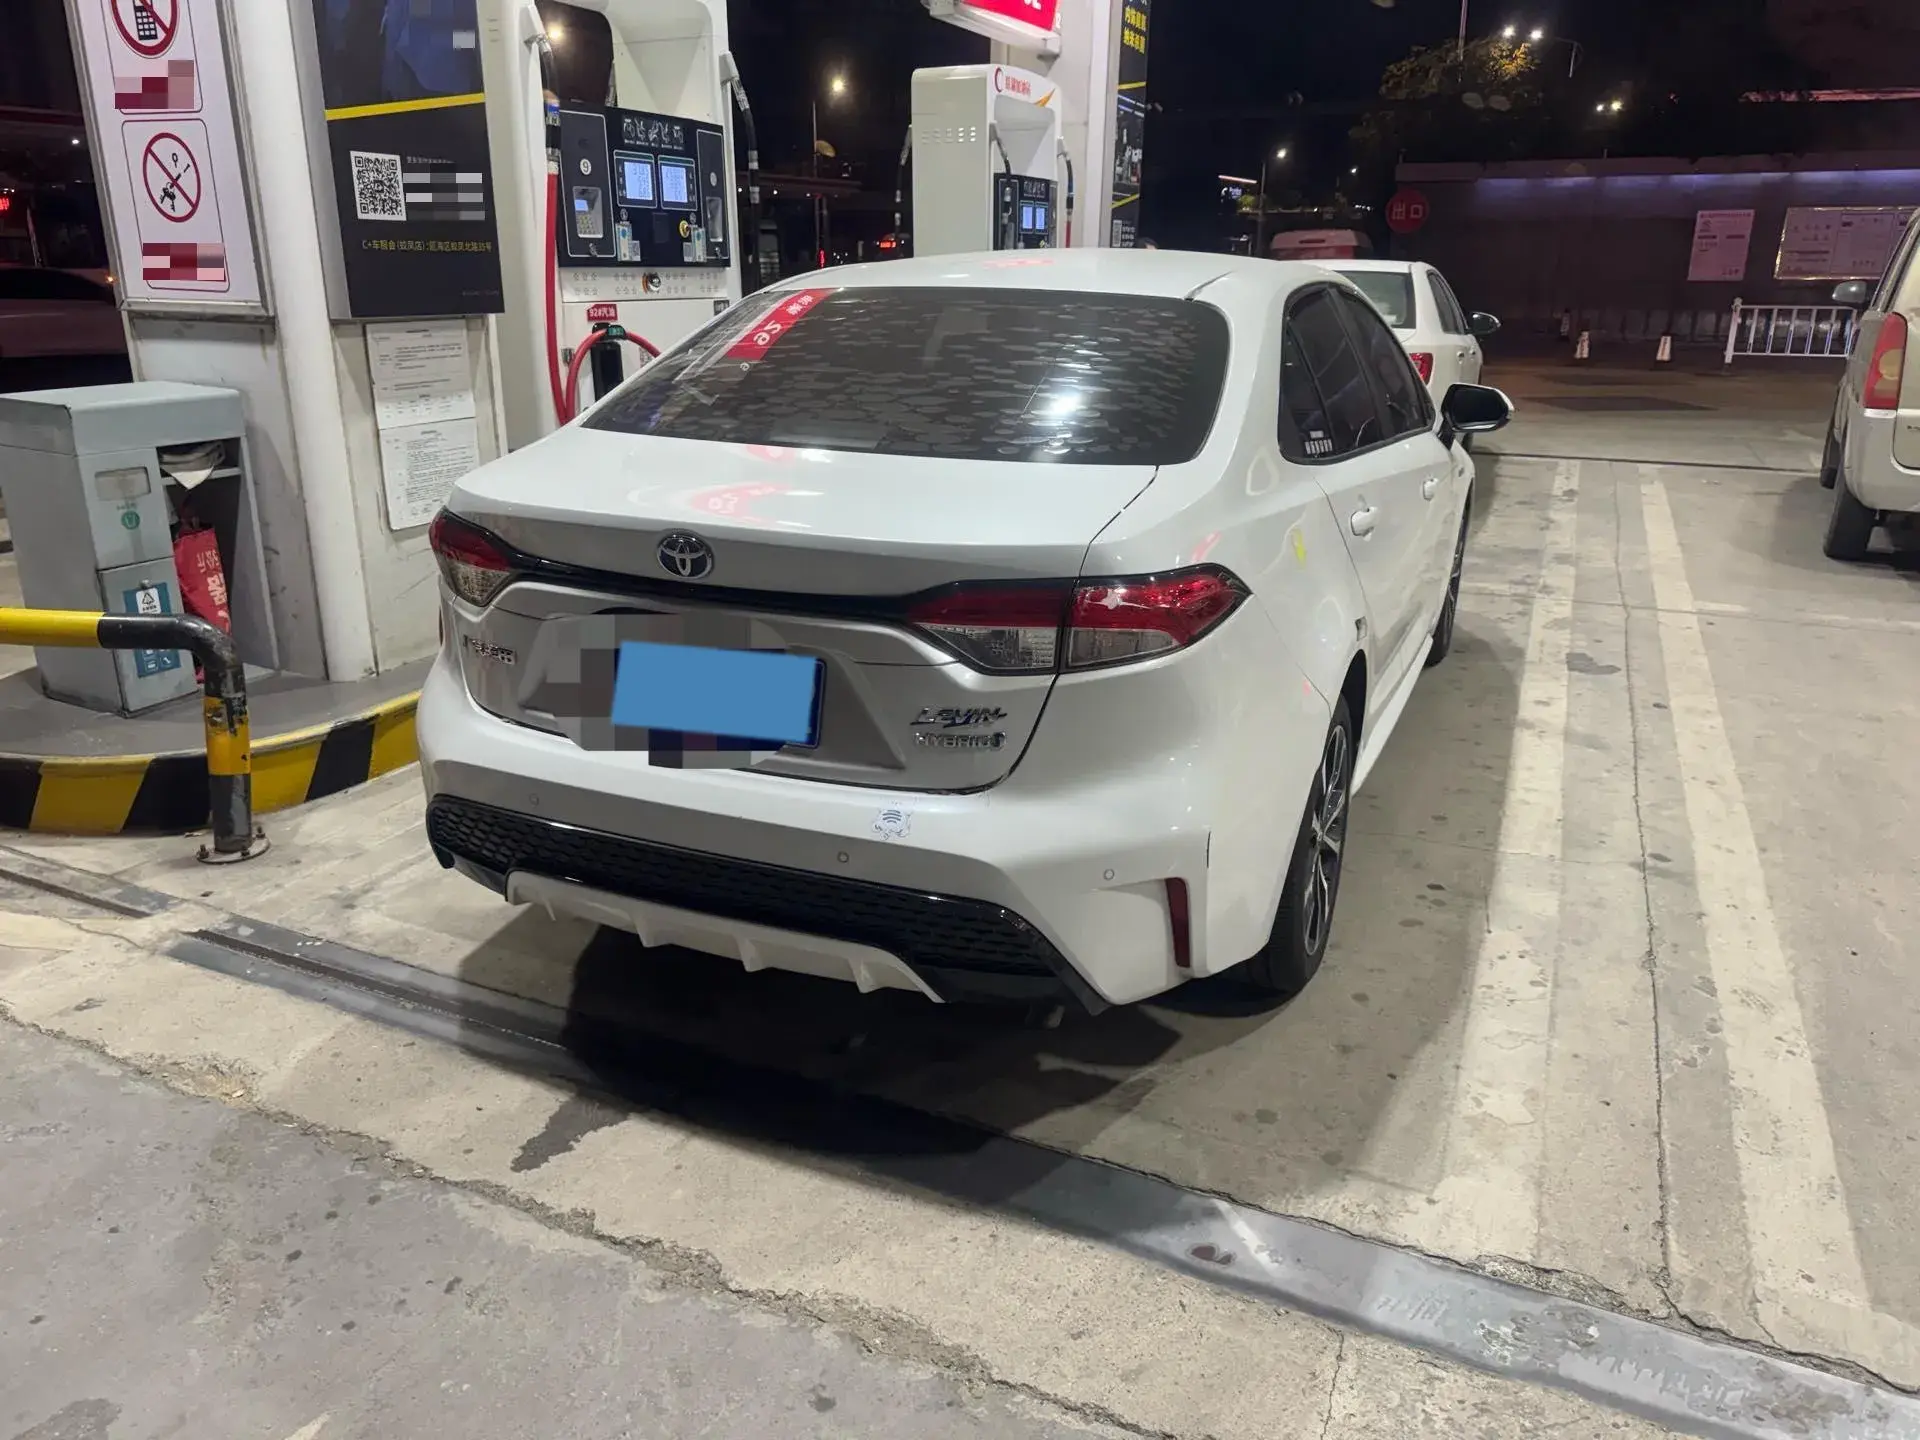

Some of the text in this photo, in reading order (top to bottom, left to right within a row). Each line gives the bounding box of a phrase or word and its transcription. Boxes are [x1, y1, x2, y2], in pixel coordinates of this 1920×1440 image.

[1392, 202, 1423, 220] 出口
[588, 306, 616, 318] 92#汽油
[910, 707, 1007, 728] LEVIN
[914, 732, 993, 748] HYBRID
